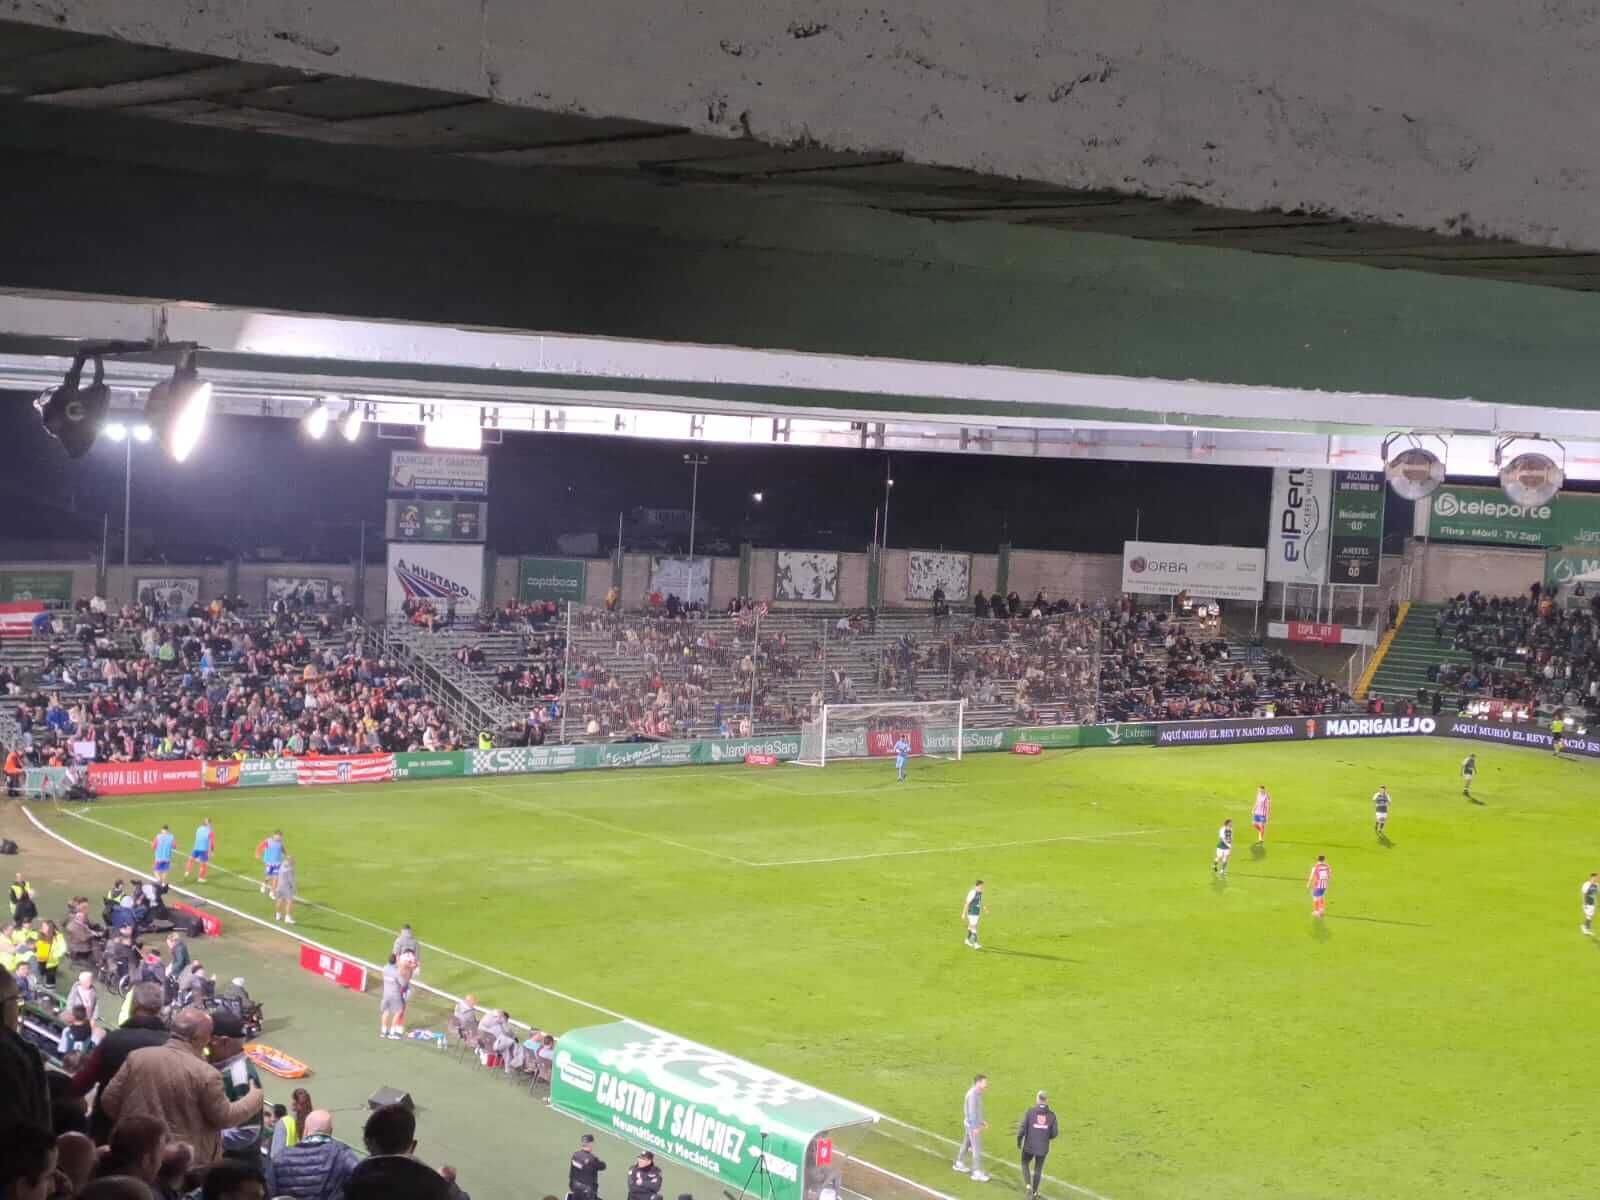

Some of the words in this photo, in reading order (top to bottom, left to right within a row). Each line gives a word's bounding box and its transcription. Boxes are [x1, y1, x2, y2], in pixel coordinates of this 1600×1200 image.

[1459, 500, 1551, 519] teleporte
[411, 564, 470, 599] HURTADO
[1160, 728, 1181, 742] AQUÍ
[1182, 727, 1208, 740] MURIÓ
[1209, 727, 1220, 739] EL
[1220, 727, 1235, 738] REY
[1235, 727, 1242, 737] Y
[1242, 725, 1265, 737] NACIÓ
[1266, 724, 1294, 736] ESPAÑA
[1325, 717, 1437, 736] MADRIGALEJO
[1451, 723, 1479, 734] AQUÍ
[1479, 726, 1511, 740] MURIÓ
[1511, 730, 1526, 741] EL
[1526, 733, 1545, 744] REY
[1560, 737, 1586, 750] ACIÓ
[102, 771, 125, 786] COPA
[126, 770, 142, 785] DEL
[143, 769, 159, 784] REY
[596, 1071, 656, 1124] CASTRO
[657, 1097, 672, 1131] Y
[670, 1104, 747, 1164] SÁNCHEZ
[612, 1115, 666, 1151] Neumáticos
[666, 1138, 674, 1154] y
[674, 1139, 721, 1173] Mecánica
